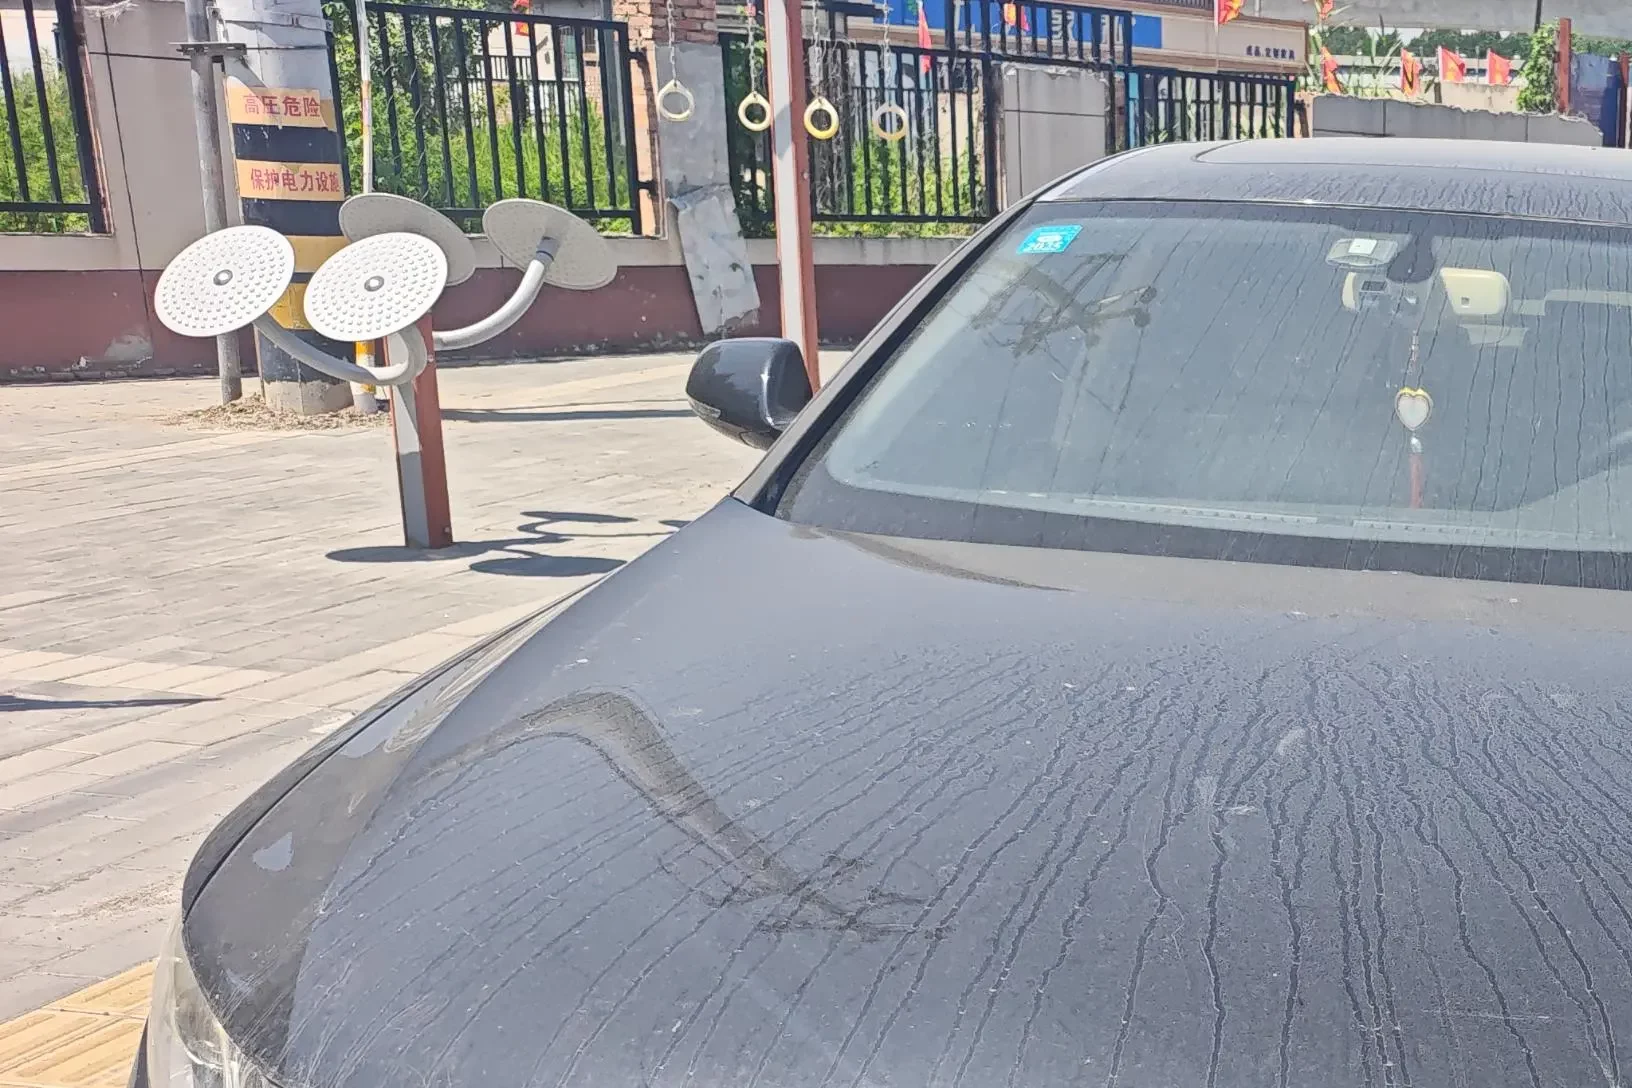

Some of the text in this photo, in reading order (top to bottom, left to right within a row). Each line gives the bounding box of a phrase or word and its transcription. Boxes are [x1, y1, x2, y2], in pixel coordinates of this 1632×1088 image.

[243, 95, 321, 117] 高压危险
[250, 168, 342, 192] 保护电力设施
